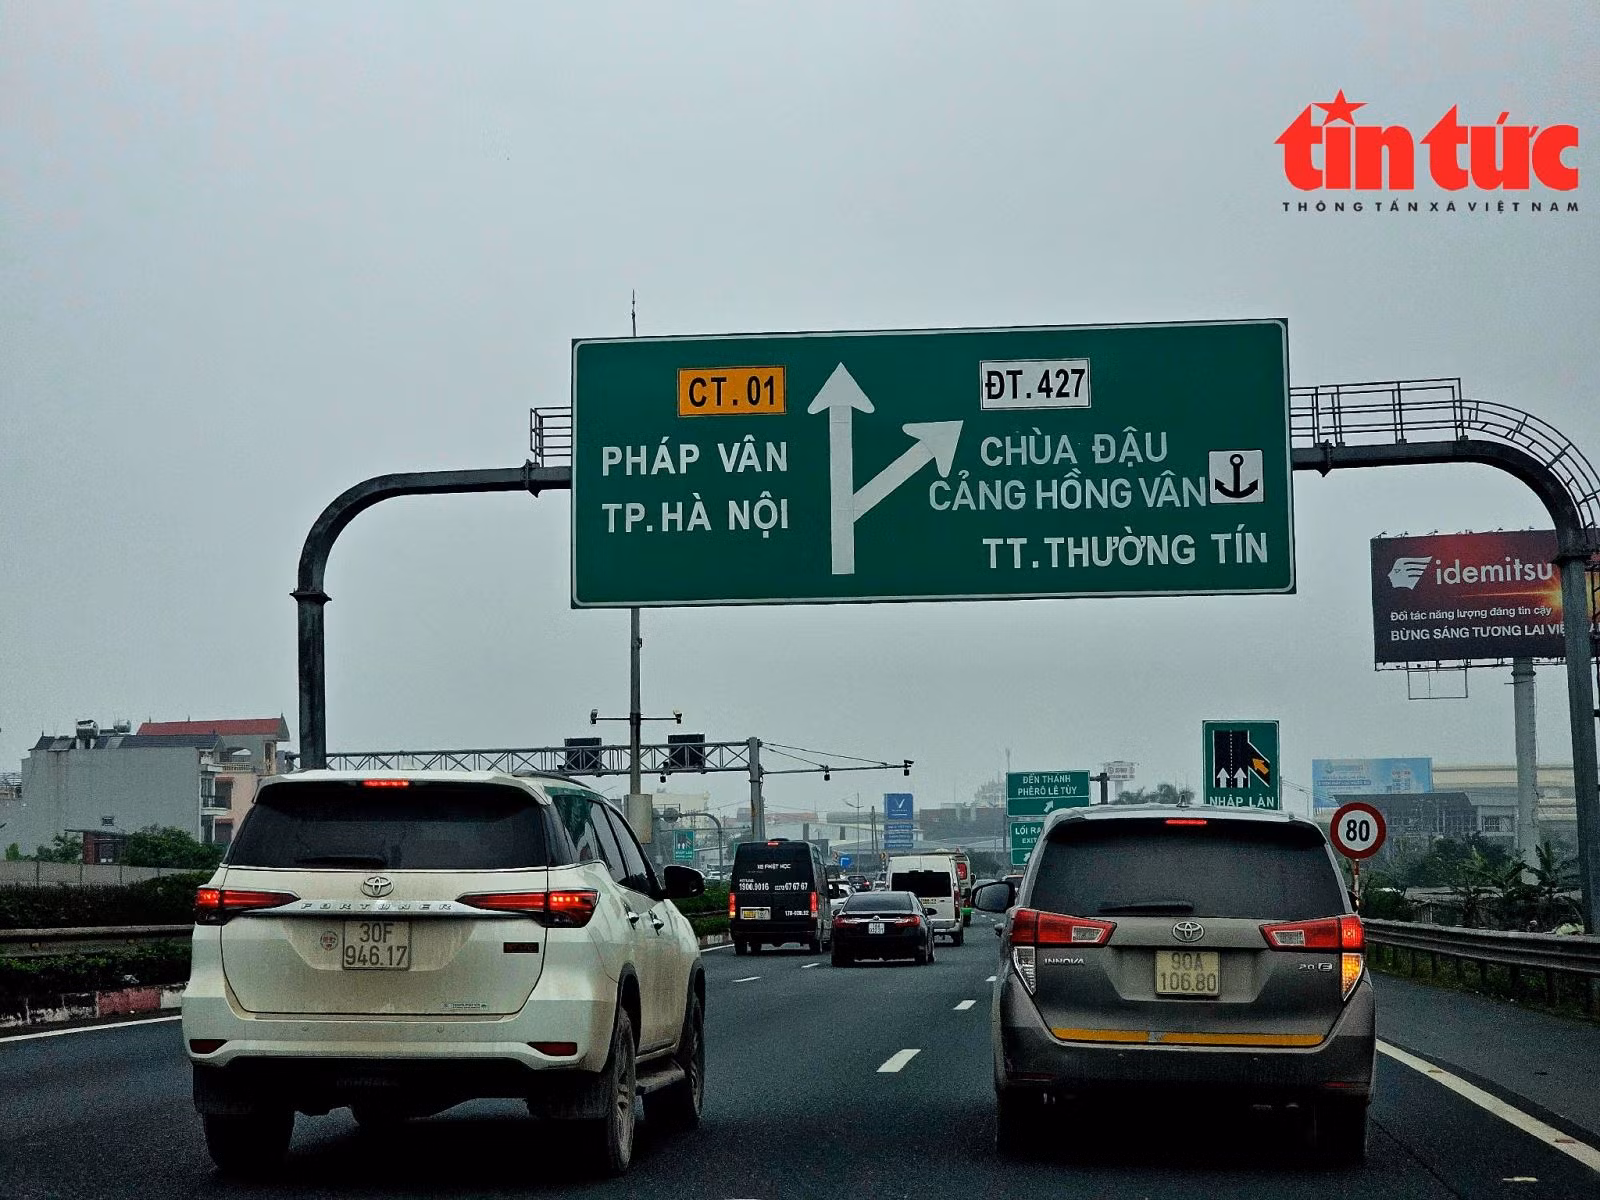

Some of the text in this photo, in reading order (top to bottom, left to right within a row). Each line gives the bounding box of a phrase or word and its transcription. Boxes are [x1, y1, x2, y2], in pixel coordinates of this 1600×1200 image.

[688, 375, 775, 407] CT.01
[984, 368, 1086, 400] ĐT.427
[602, 434, 788, 476] PHÁP VÂN
[980, 426, 1168, 467] CHÙA ĐẬU
[929, 467, 1207, 511] CẢNG HỒNG VÂN
[728, 490, 788, 538] NỘI
[1210, 524, 1268, 564] TÍN
[1435, 556, 1553, 585] idemitsu
[1410, 610, 1427, 620] tác
[1429, 609, 1455, 620] năng
[1457, 608, 1488, 619] lượng
[1489, 607, 1516, 618] đáng
[1518, 605, 1531, 615] tin
[1533, 605, 1552, 617] cậy
[1391, 628, 1431, 641] BỪNG
[1433, 625, 1470, 639] SÁNG
[1472, 624, 1522, 638] TƯƠNG
[1524, 624, 1545, 636] LAI
[1346, 819, 1370, 842] 80
[301, 902, 453, 910] FORTUNER
[359, 922, 394, 943] 30F
[345, 944, 408, 966] 946.17
[1171, 952, 1204, 971] 90A
[1160, 972, 1217, 992] 106.80
